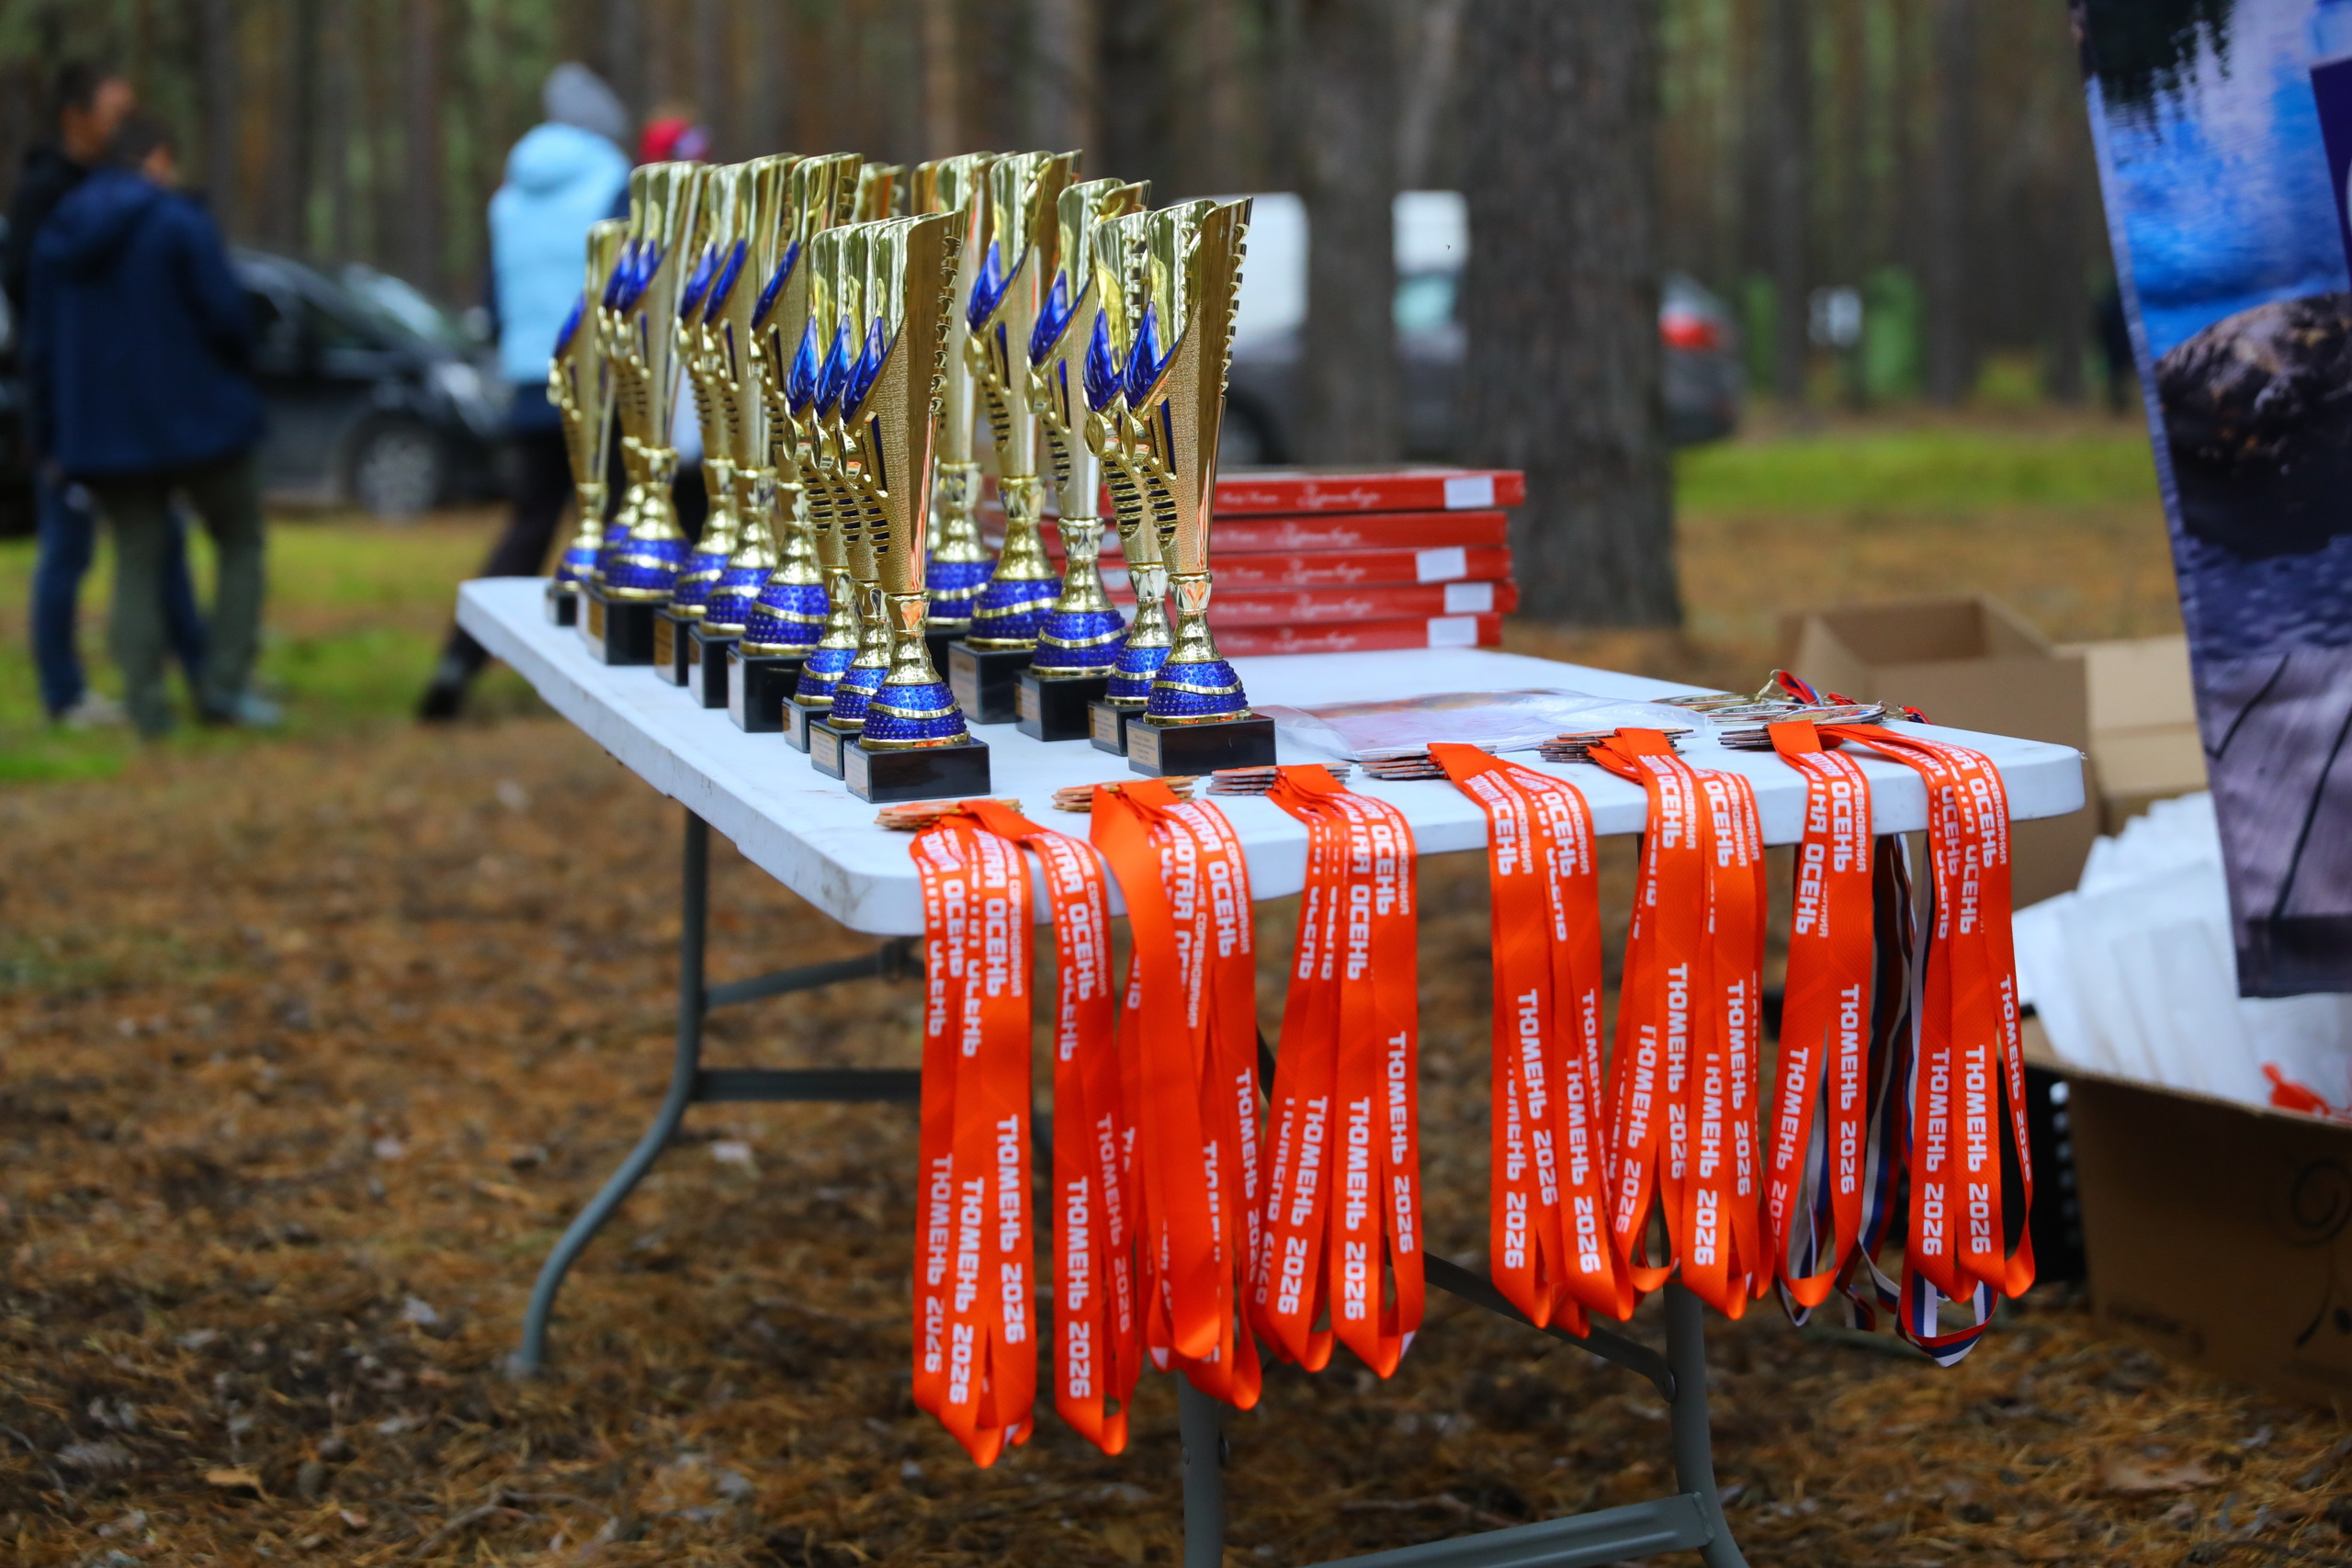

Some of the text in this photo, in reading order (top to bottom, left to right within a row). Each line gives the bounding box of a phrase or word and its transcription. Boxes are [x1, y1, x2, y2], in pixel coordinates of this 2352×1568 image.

[1371, 824, 1396, 916] ОСЕНЬ
[1490, 797, 1518, 875] ОСЕНЬ
[1542, 790, 1577, 878] ОСЕНЬ
[1657, 774, 1683, 849] ОСЕНЬ
[1703, 779, 1735, 867] ОСЕНЬ
[1830, 781, 1853, 873] ОСЕНЬ
[1849, 772, 1867, 873] СОРЕВНОВАНИЯ
[1940, 784, 1961, 877] ОСЕНЬ
[1969, 777, 1997, 868] ОСЕНЬ
[1979, 759, 2007, 865] СОРЕВНОВАНИЯ
[985, 897, 1008, 998] ОСЕНЬ
[1009, 880, 1023, 997] СОРЕВНОВАНИЯ
[1069, 902, 1094, 1000] ОСЕНЬ
[1208, 861, 1238, 957] ОСЕНЬ
[1224, 840, 1250, 955] СОРЕВНОВАНИЯ
[1347, 885, 1371, 980] ОСЕНЬ
[1795, 842, 1826, 935] ОСЕНЬ
[1960, 843, 1980, 935] ОСЕНЬ
[1518, 988, 1559, 1206] ТЮМЕНЬ 2026
[1581, 987, 1601, 1119] ТЮМЕНЬ
[1626, 1023, 1657, 1148] ТЮМЕНЬ
[1668, 962, 1689, 1179] ТЮМЕНЬ 2026
[1727, 979, 1751, 1197] ТЮМЕНЬ 2026
[1840, 983, 1860, 1194] ТЮМЕНЬ 2026
[1999, 974, 2032, 1182] ТЮМЕНЬ 2026
[1236, 1067, 1259, 1200] ТЮМЕНЬ
[1387, 1031, 1414, 1254] ТЮМЕНЬ 2026
[1566, 1053, 1602, 1274] ТЮМЕНЬ 2026
[1615, 1157, 1642, 1234] 2026
[1694, 1053, 1723, 1266] ТЮМЕНЬ 2026
[1770, 1046, 1809, 1253] ТЮМЕНЬ 202
[1922, 1047, 1951, 1256] ТЮМЕНЬ 2026
[1965, 1044, 1991, 1254] ТЮМЕНЬ 2026
[927, 1153, 953, 1286] ТЮМЕНЬ
[997, 1114, 1026, 1344] ТЮМЕНЬ 2026
[1097, 1111, 1131, 1333] ТЮМЕНЬ 2026
[1278, 1095, 1329, 1314] ТЮМЕНЬ 2026
[1344, 1096, 1370, 1320] ТЮМЕНЬ 2026
[1504, 1191, 1526, 1269] 2026
[949, 1176, 985, 1404] ТЮМЕНЬ 2026
[1068, 1176, 1091, 1398] ТЮМЕНЬ 2026
